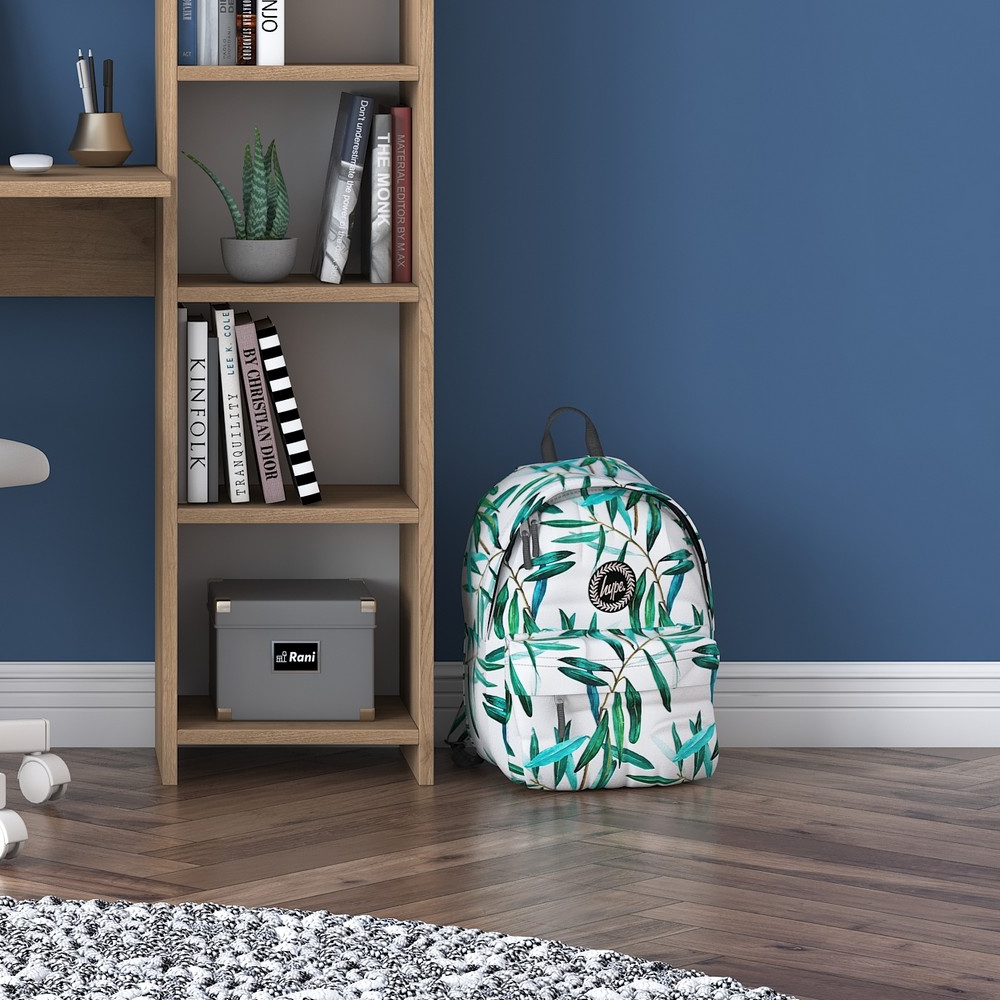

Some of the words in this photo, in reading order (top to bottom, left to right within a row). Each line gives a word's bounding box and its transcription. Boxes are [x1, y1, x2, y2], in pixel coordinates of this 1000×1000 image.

[357, 99, 369, 121] Don't
[348, 122, 363, 179] underestimate
[377, 132, 391, 167] THE
[396, 134, 406, 184] MATERIAL
[345, 180, 354, 194] the
[377, 173, 391, 226] MONK
[341, 194, 350, 219] power
[396, 186, 406, 224] EDITOR
[396, 226, 406, 241] BY
[396, 243, 406, 268] M.AX
[222, 311, 232, 337] COLE
[225, 342, 233, 352] K.
[243, 348, 258, 366] BY
[226, 358, 235, 375] LEE
[189, 358, 206, 470] KINFOLK
[246, 369, 272, 441] CHRISTIAN
[228, 394, 246, 496] TRANQUILITY
[261, 445, 278, 480] DIOR
[289, 651, 316, 663] Rani
